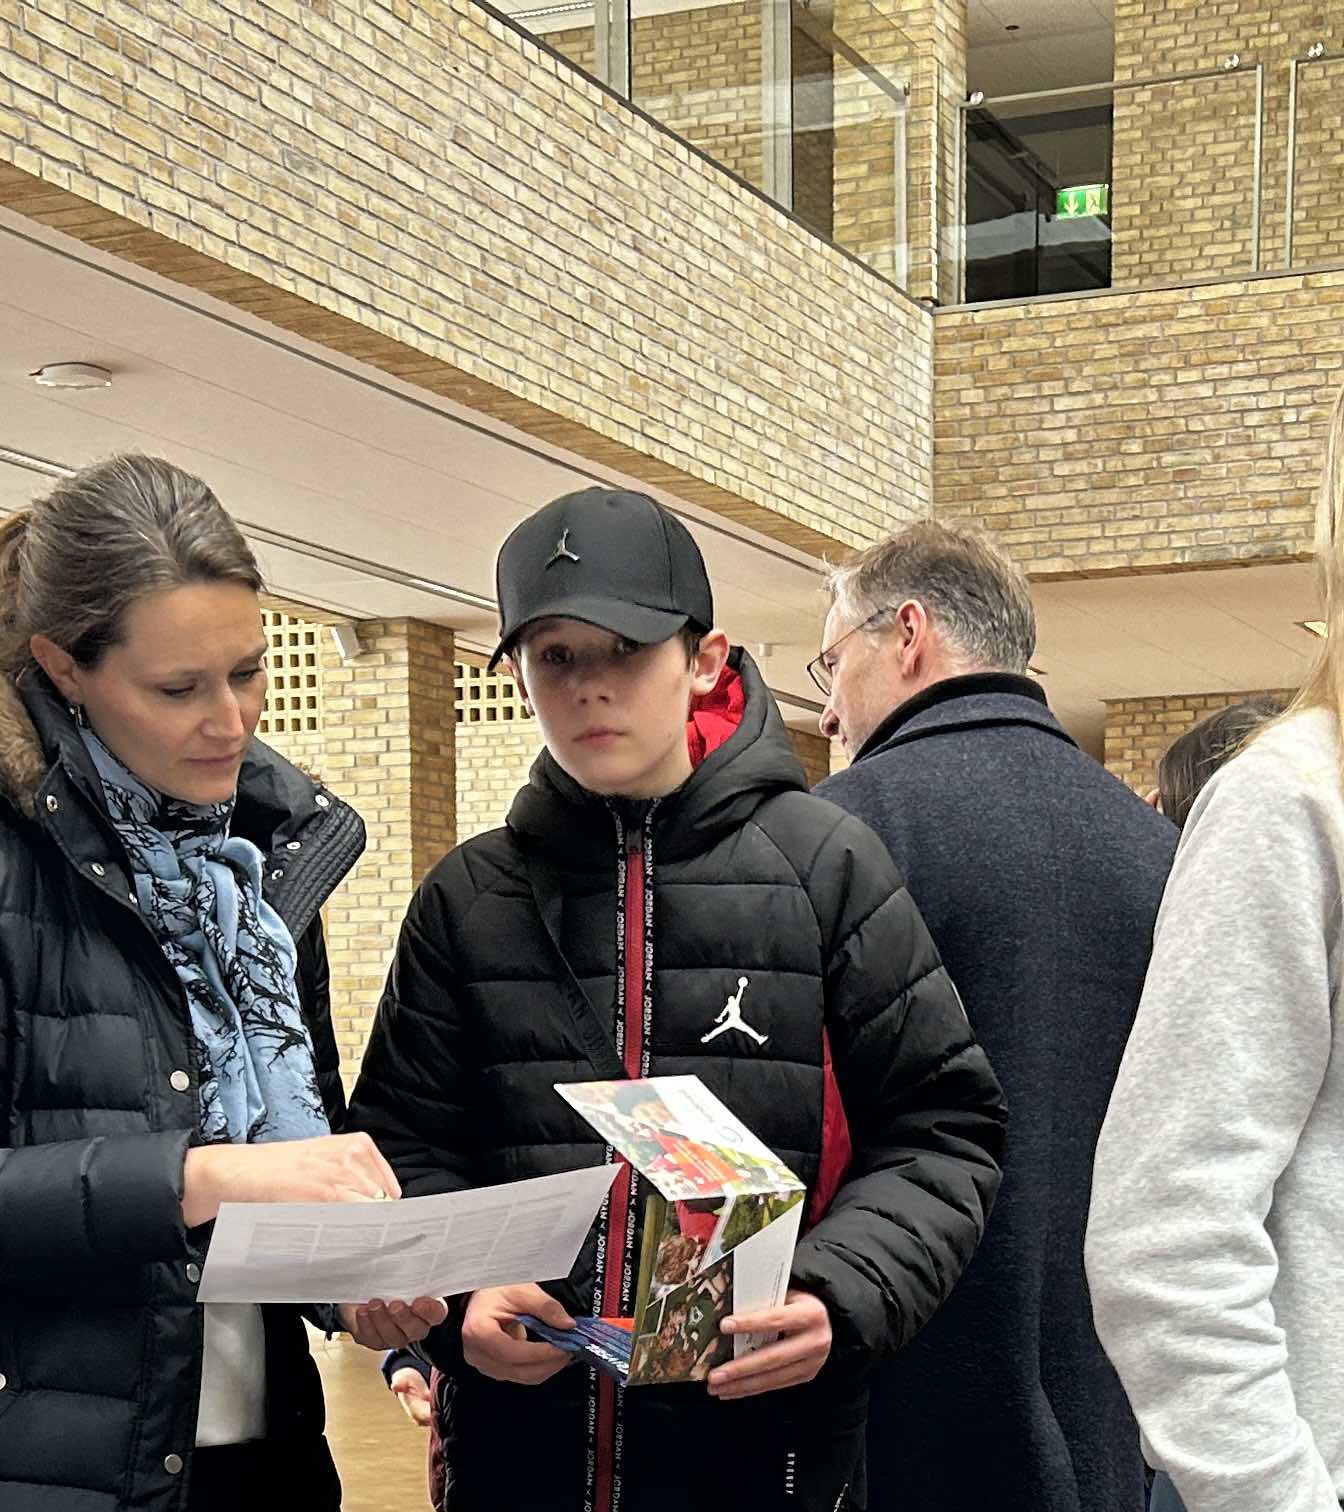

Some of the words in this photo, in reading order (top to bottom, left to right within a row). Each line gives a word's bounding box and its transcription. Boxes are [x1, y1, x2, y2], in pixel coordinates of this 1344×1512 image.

[643, 994, 653, 1036] JORDAN
[625, 1209, 637, 1249] JORDAN
[596, 1232, 606, 1274] JORDAN
[621, 1261, 633, 1302] JORDAN
